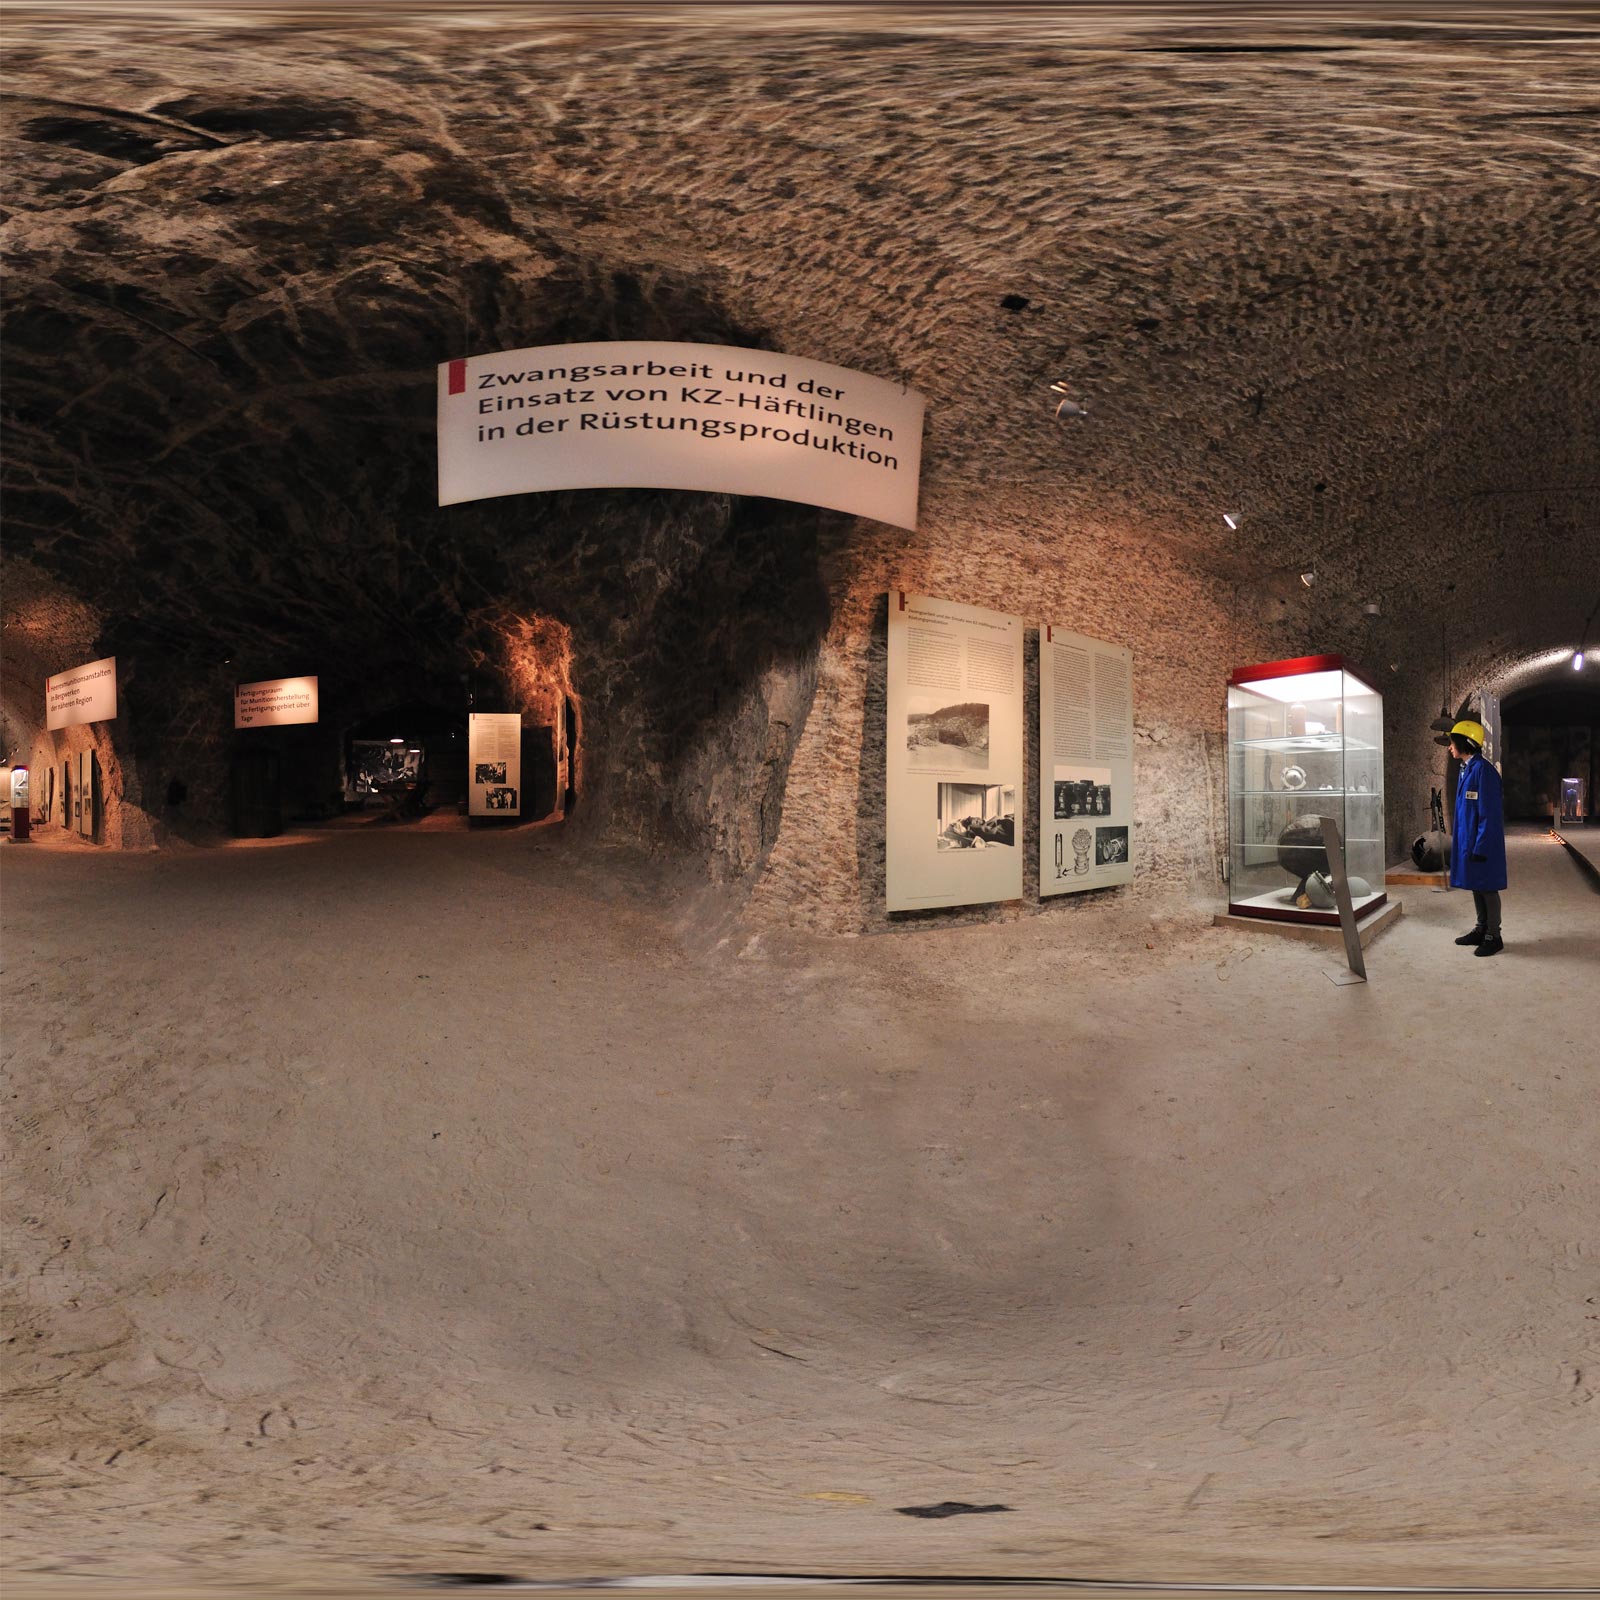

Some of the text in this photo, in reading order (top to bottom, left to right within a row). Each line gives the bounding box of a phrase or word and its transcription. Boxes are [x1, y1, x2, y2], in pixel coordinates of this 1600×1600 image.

[478, 361, 846, 401] Zwangsarbeit und der
[479, 387, 894, 441] Einsatz von KZ-Häftlingen
[478, 412, 898, 470] in der Rüstungsproduktion
[76, 696, 93, 706] Region
